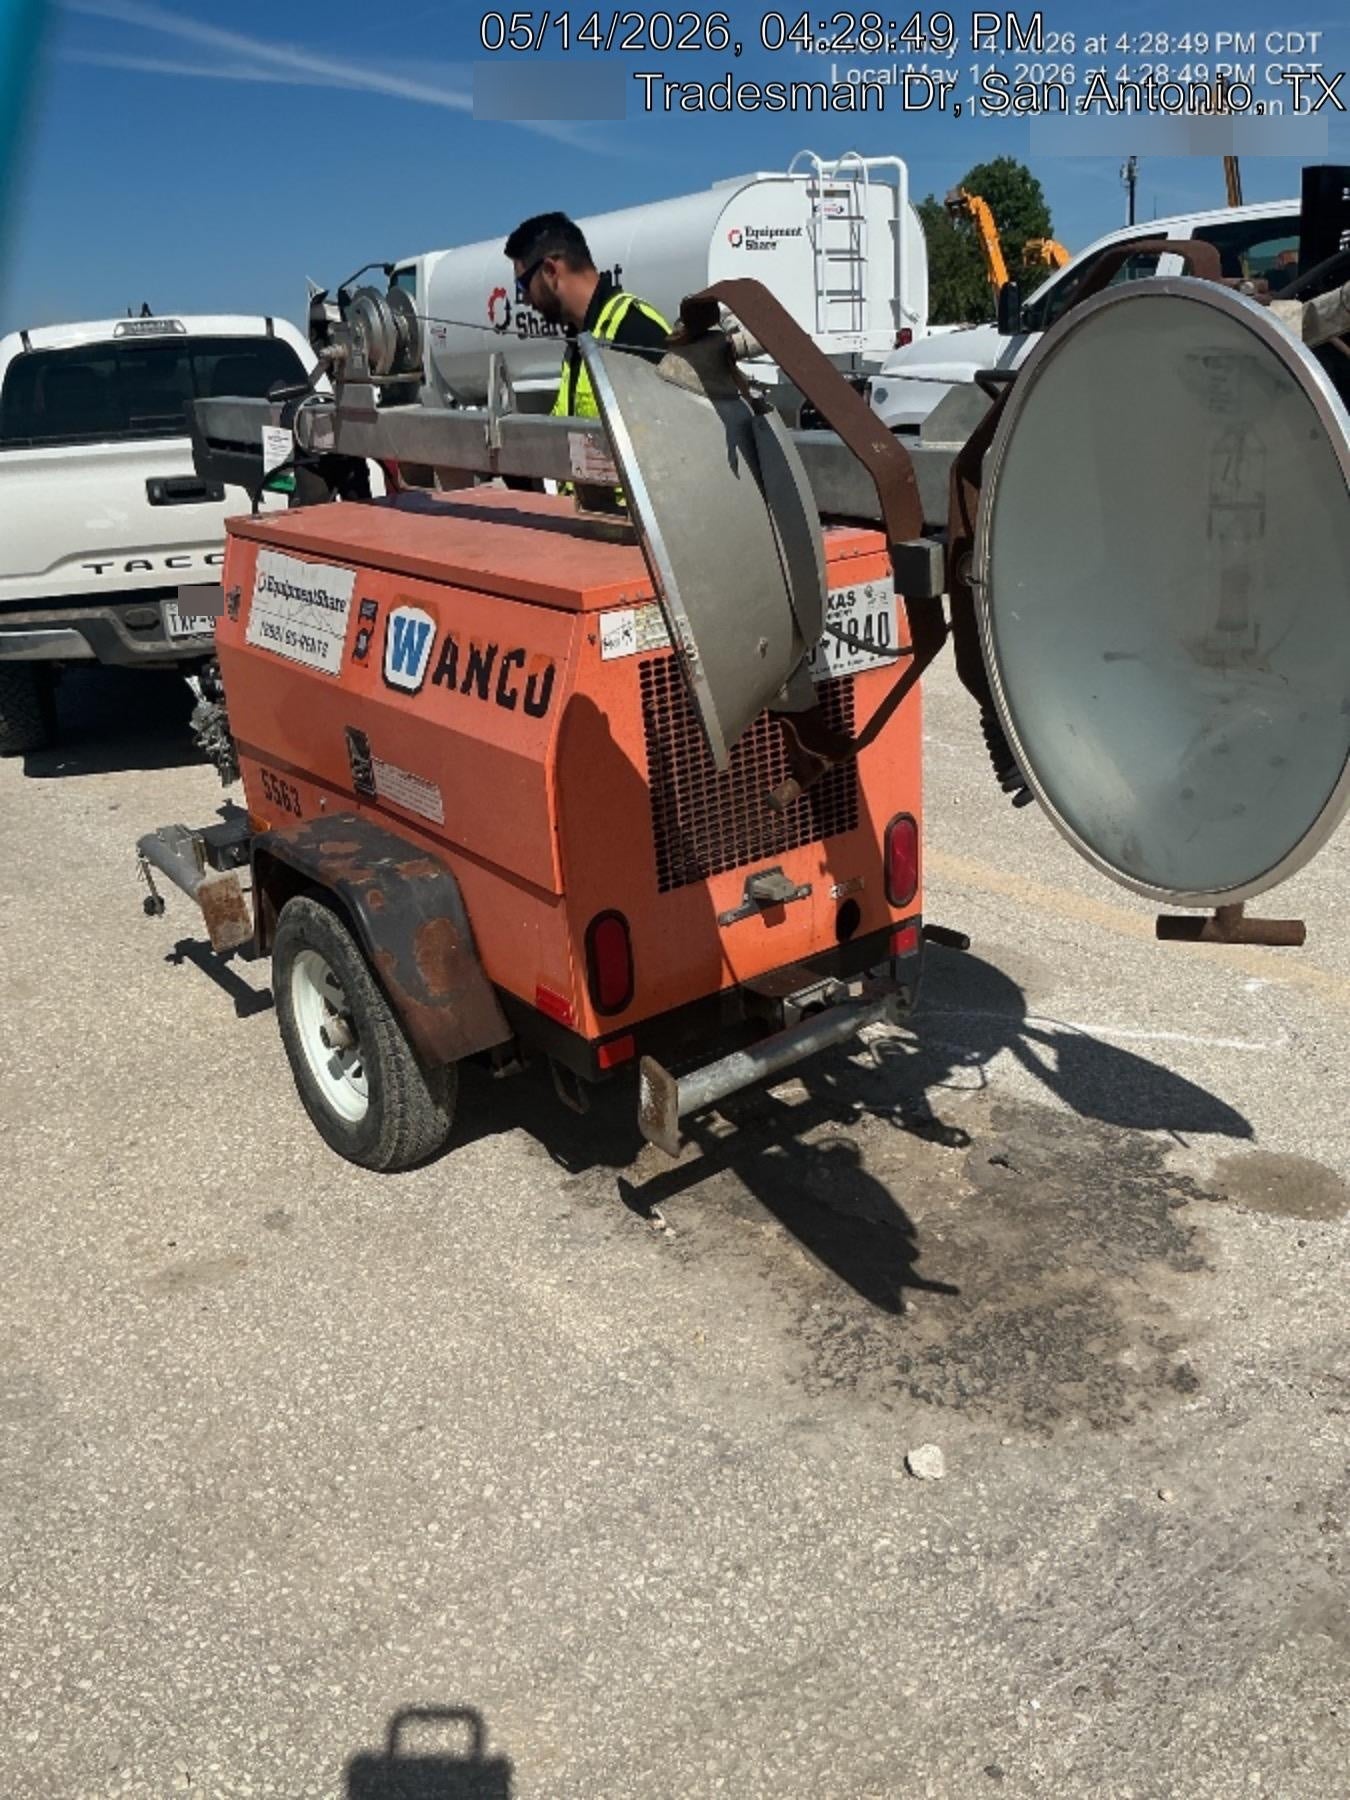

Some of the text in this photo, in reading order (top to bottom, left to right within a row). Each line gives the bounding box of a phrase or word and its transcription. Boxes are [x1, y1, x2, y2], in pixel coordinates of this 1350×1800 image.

[744, 226, 803, 239] Equipment
[744, 240, 778, 251] Share
[82, 553, 225, 575] TACO
[827, 590, 856, 611] XAS
